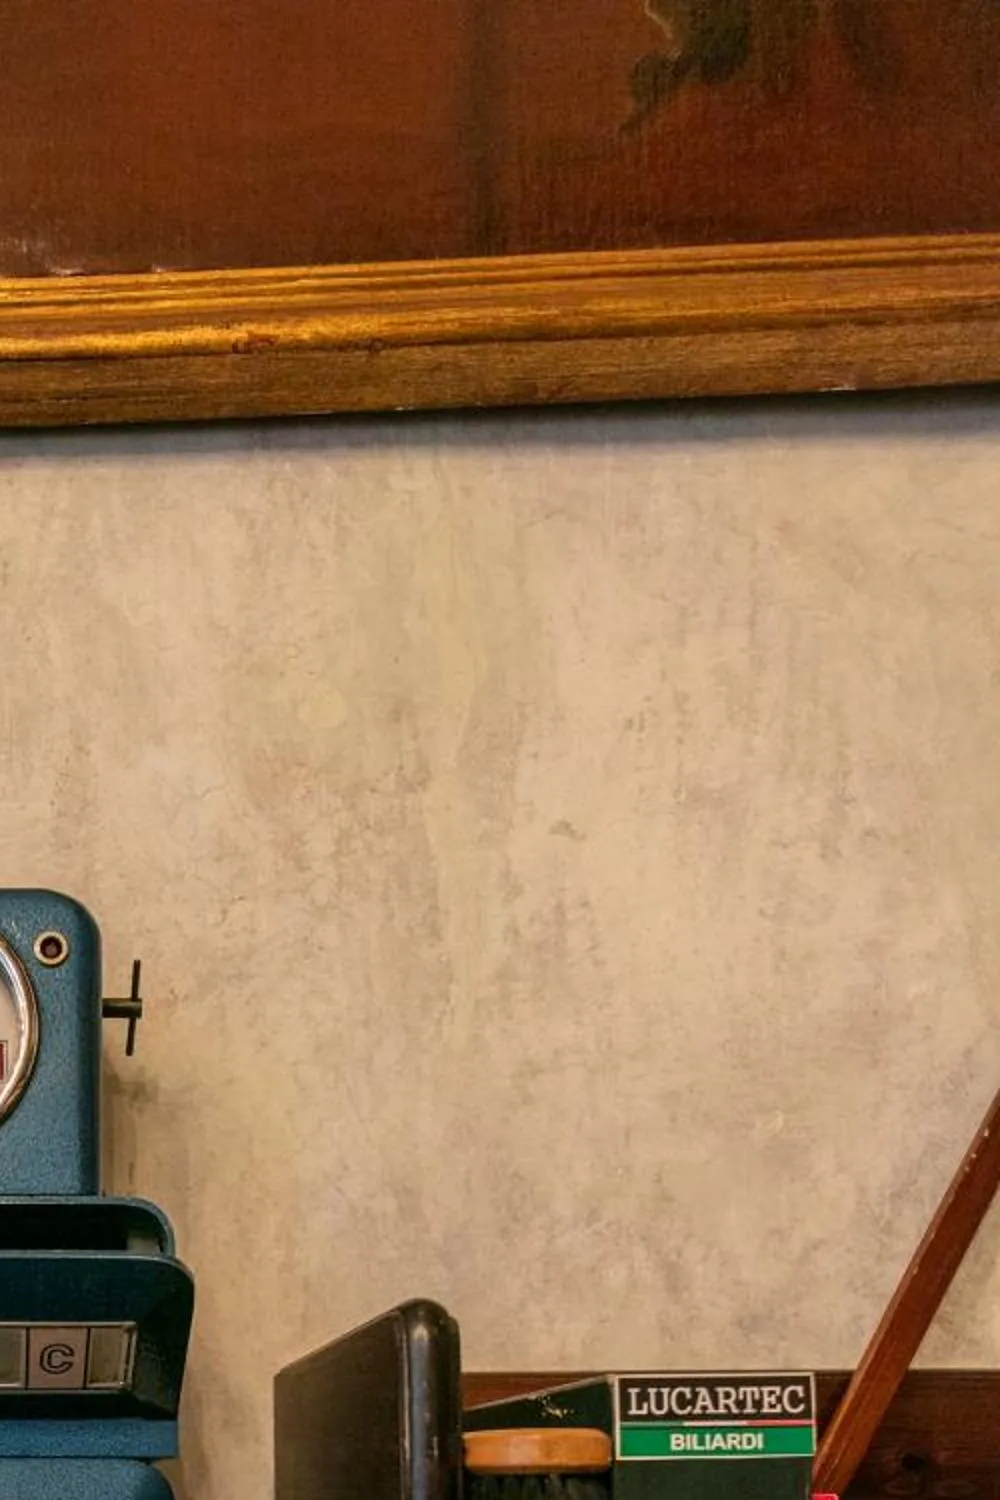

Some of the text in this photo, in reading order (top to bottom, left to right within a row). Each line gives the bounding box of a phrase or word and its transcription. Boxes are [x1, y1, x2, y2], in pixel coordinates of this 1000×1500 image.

[39, 1343, 75, 1375] C
[627, 1385, 806, 1416] LUCARTEC
[669, 1432, 764, 1451] BILIARDI
